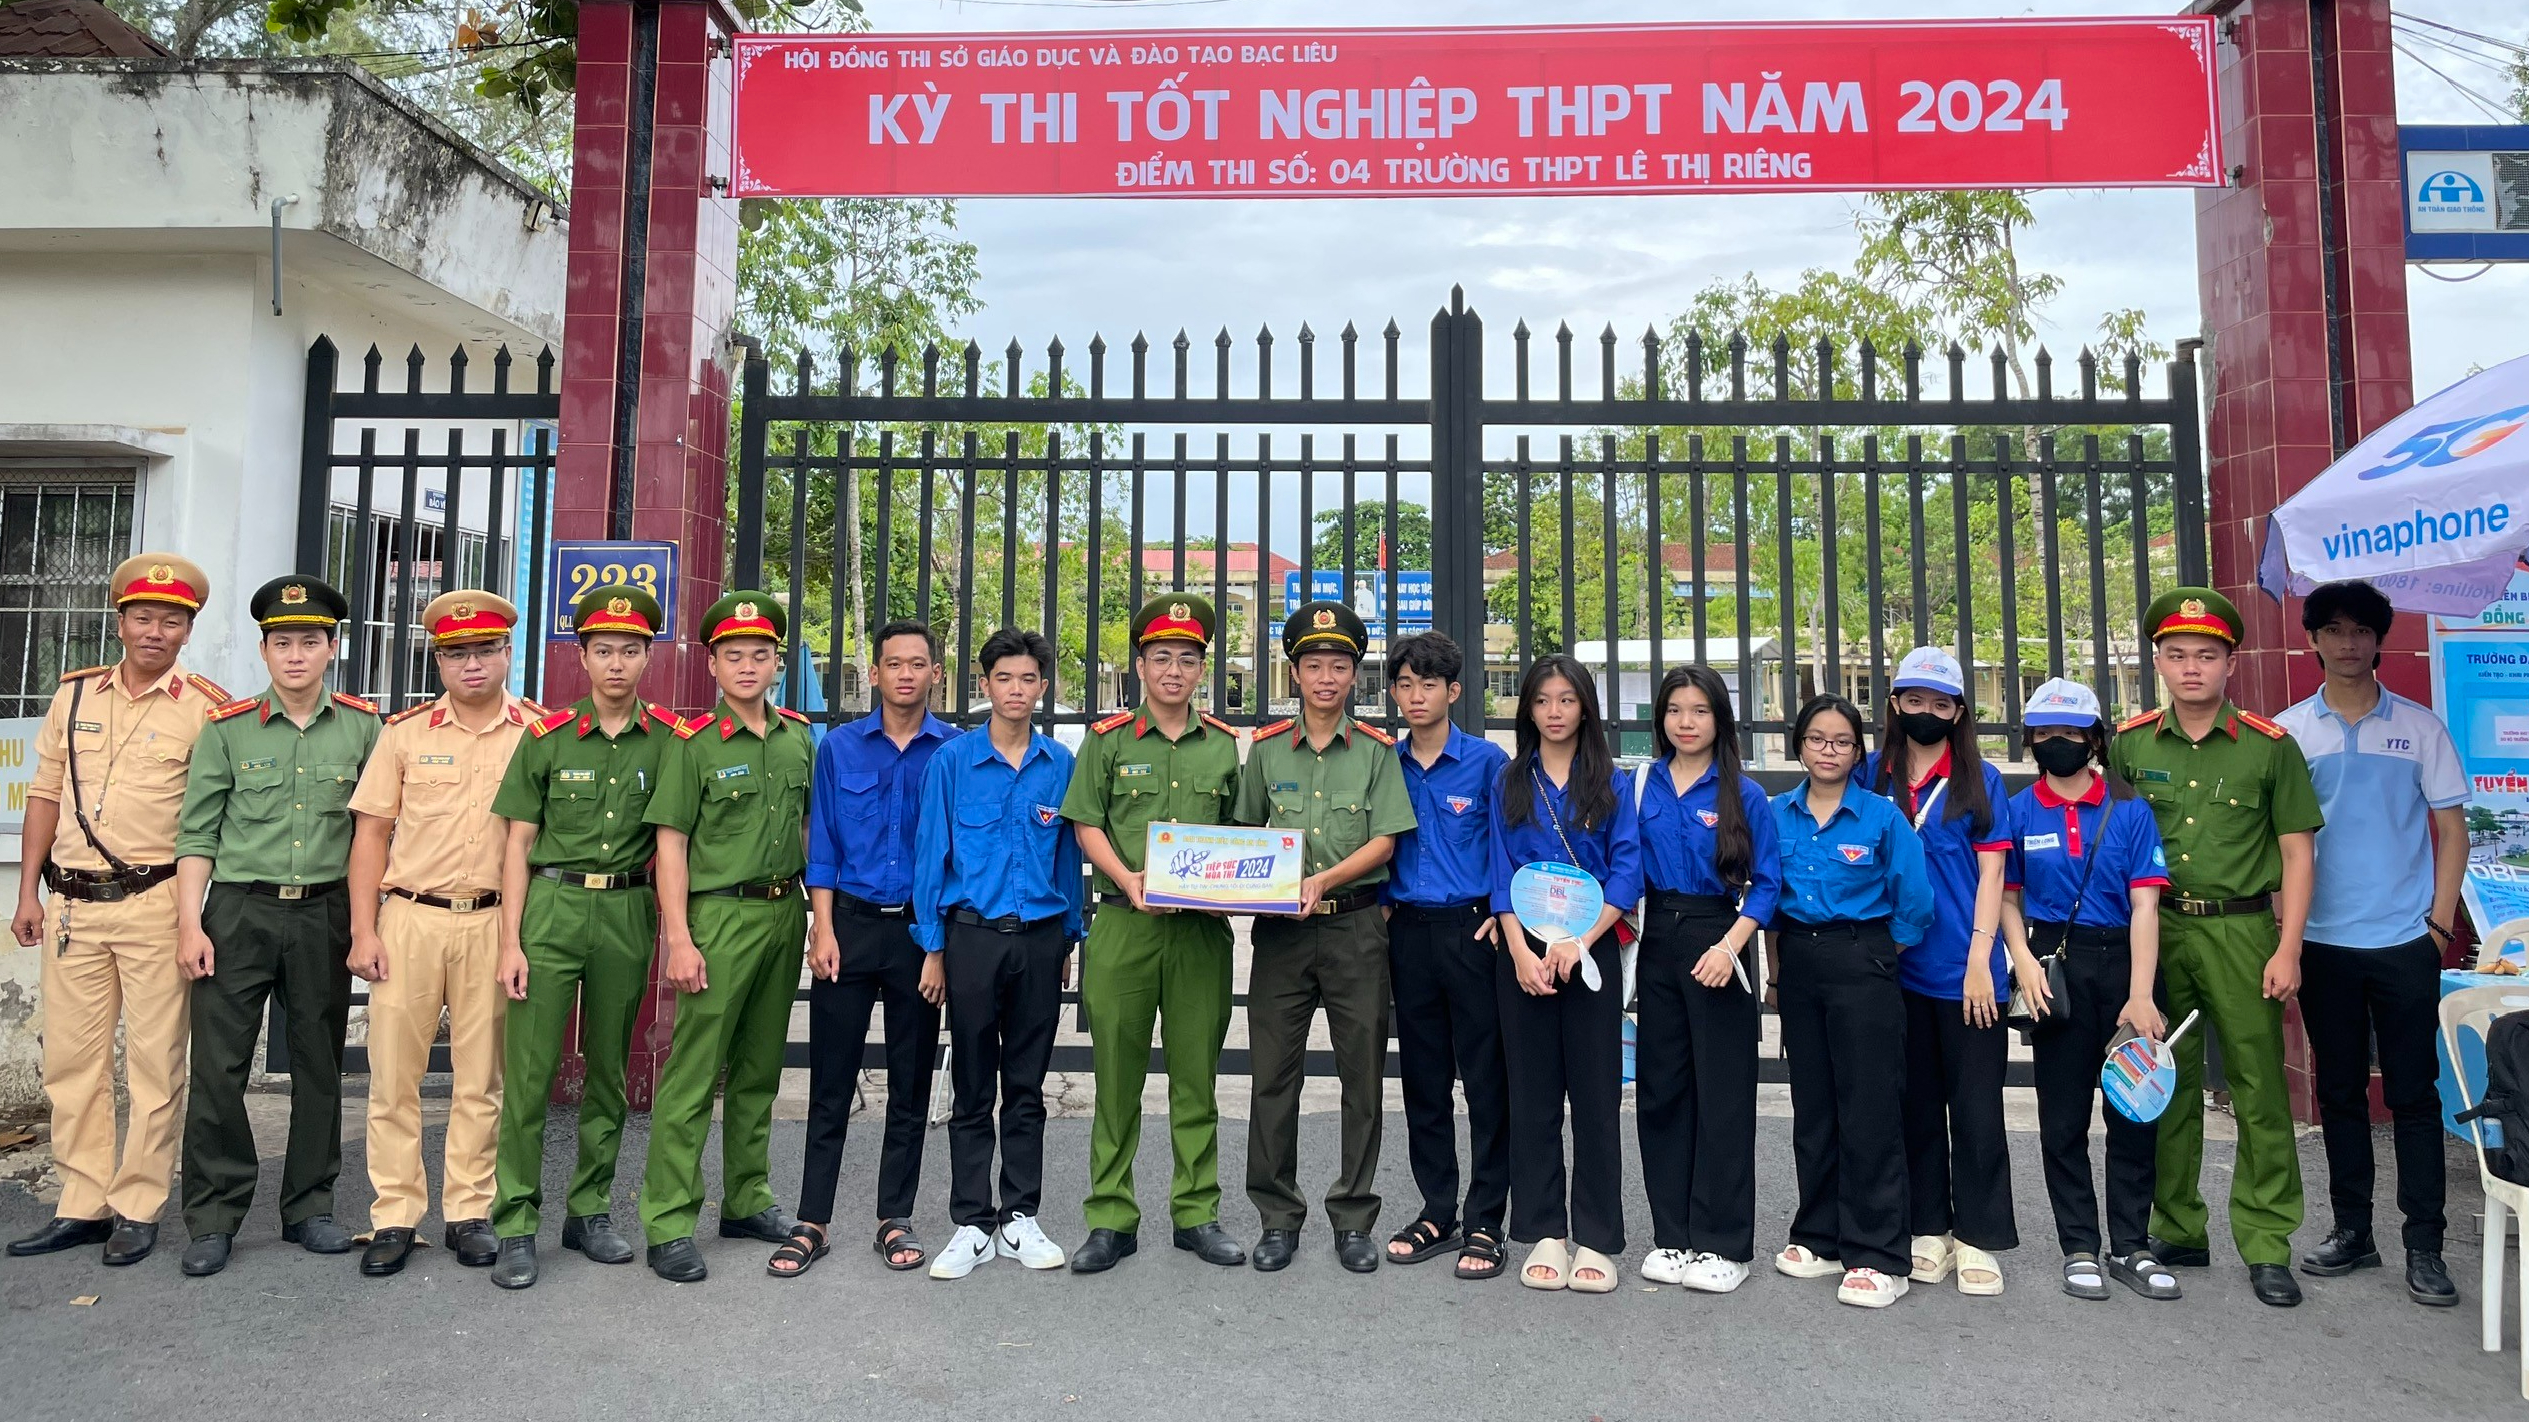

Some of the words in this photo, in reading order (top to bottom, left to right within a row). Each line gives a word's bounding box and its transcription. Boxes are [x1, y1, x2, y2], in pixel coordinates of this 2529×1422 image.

[784, 48, 820, 73] HỘI
[828, 44, 889, 69] ĐỒNG
[897, 49, 931, 68] THI
[939, 44, 969, 68] SỞ
[976, 44, 1029, 67] GIÁO
[1036, 48, 1081, 70] DỤC
[1088, 43, 1122, 66] VÀ
[1129, 42, 1180, 65] ĐÀO
[1187, 45, 1233, 68] TẠO
[1240, 44, 1285, 67] BẠC
[1292, 41, 1338, 64] LIÊU
[868, 81, 952, 145] KỲ
[980, 92, 1078, 144] THI
[1106, 71, 1230, 142] TỐT
[1259, 75, 1478, 151] NGHIỆP
[1506, 83, 1673, 138] THPT
[1702, 70, 1869, 134] NĂM
[1897, 78, 2069, 133] 2024
[1114, 150, 1195, 188] ĐIỂM
[1209, 159, 1256, 186] THI
[1269, 151, 1317, 186] SỐ:
[1328, 158, 1371, 185] 04
[1384, 149, 1510, 184] TRƯỜNG
[1523, 155, 1602, 182] THPT
[1615, 149, 1648, 181] LÊ
[1662, 154, 1711, 185] THỊ
[1723, 147, 1812, 180] RIÊNG
[2322, 503, 2510, 561] vinaphone
[2482, 604, 2526, 624] ĐỒNG
[2466, 653, 2516, 665] TRƯỜNG
[2387, 738, 2410, 750] YTC
[2474, 767, 2528, 793] TUYỂN
[1239, 857, 1270, 878] 2024
